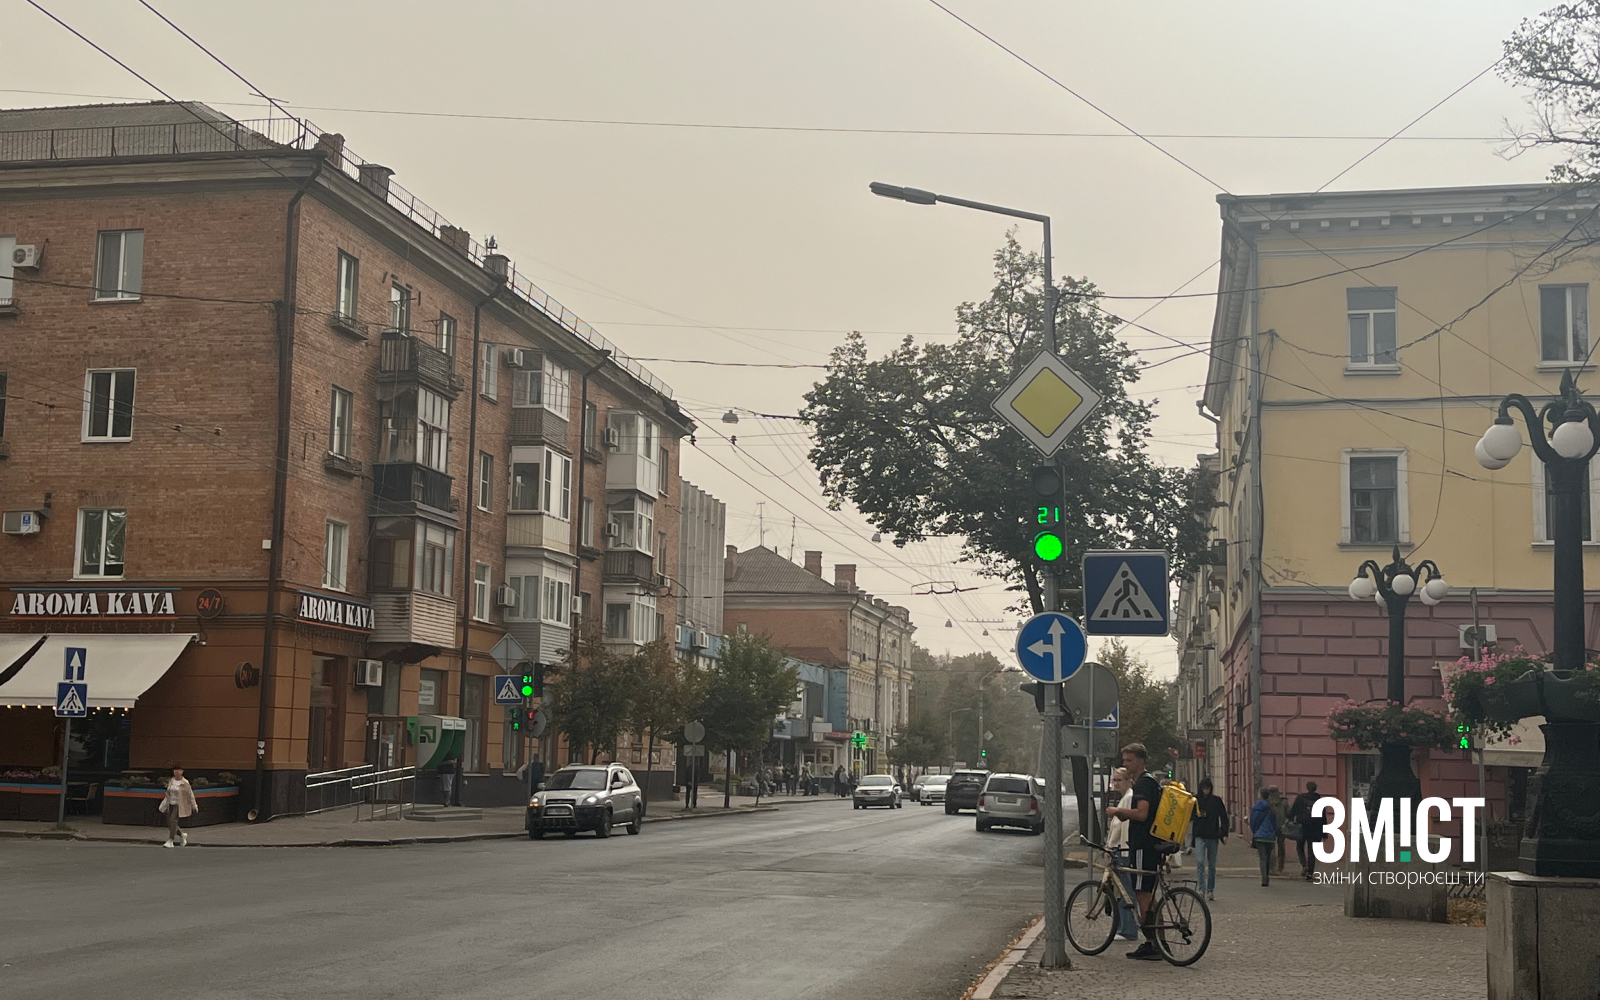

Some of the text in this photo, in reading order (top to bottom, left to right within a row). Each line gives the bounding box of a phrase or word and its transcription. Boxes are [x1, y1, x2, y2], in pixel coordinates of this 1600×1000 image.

[1037, 506, 1060, 524] 21
[9, 592, 176, 615] AROMA KAVA
[198, 597, 221, 609] 24/7
[299, 595, 376, 630] AROMA KAVA
[522, 675, 532, 683] 21
[1163, 797, 1178, 826] Glovo
